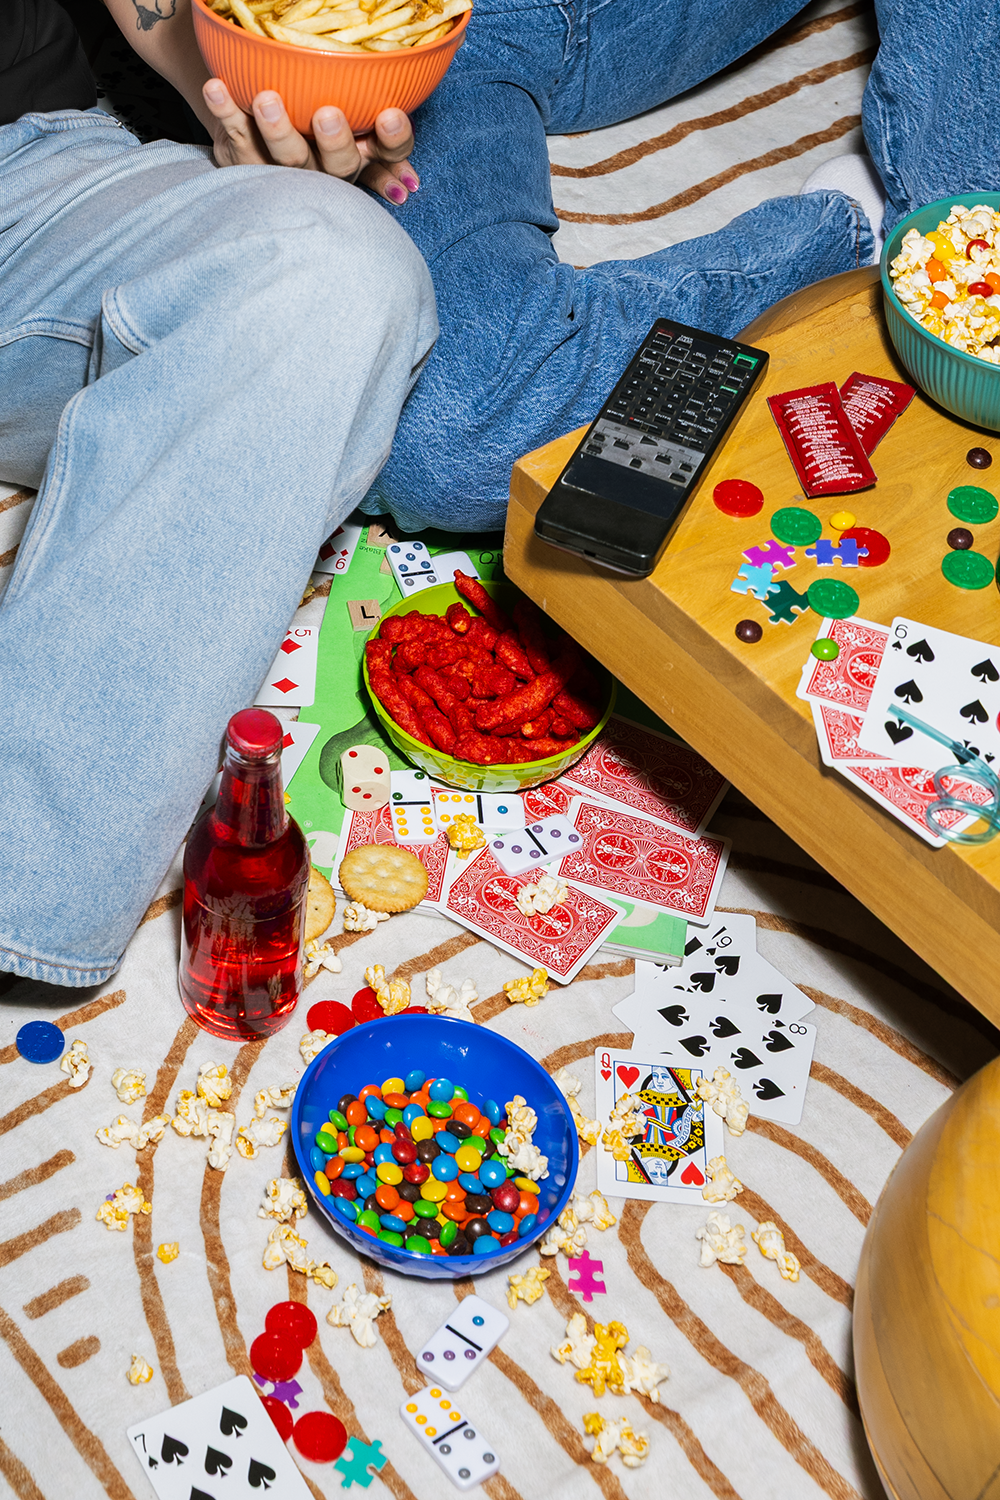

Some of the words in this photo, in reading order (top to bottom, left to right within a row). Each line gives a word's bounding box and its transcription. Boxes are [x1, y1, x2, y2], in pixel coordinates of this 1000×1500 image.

[360, 605, 375, 619] L
[295, 628, 311, 638] 5
[894, 624, 908, 639] 6
[789, 1023, 807, 1036] 8
[600, 1052, 612, 1069] Q
[133, 1433, 148, 1453] 7
